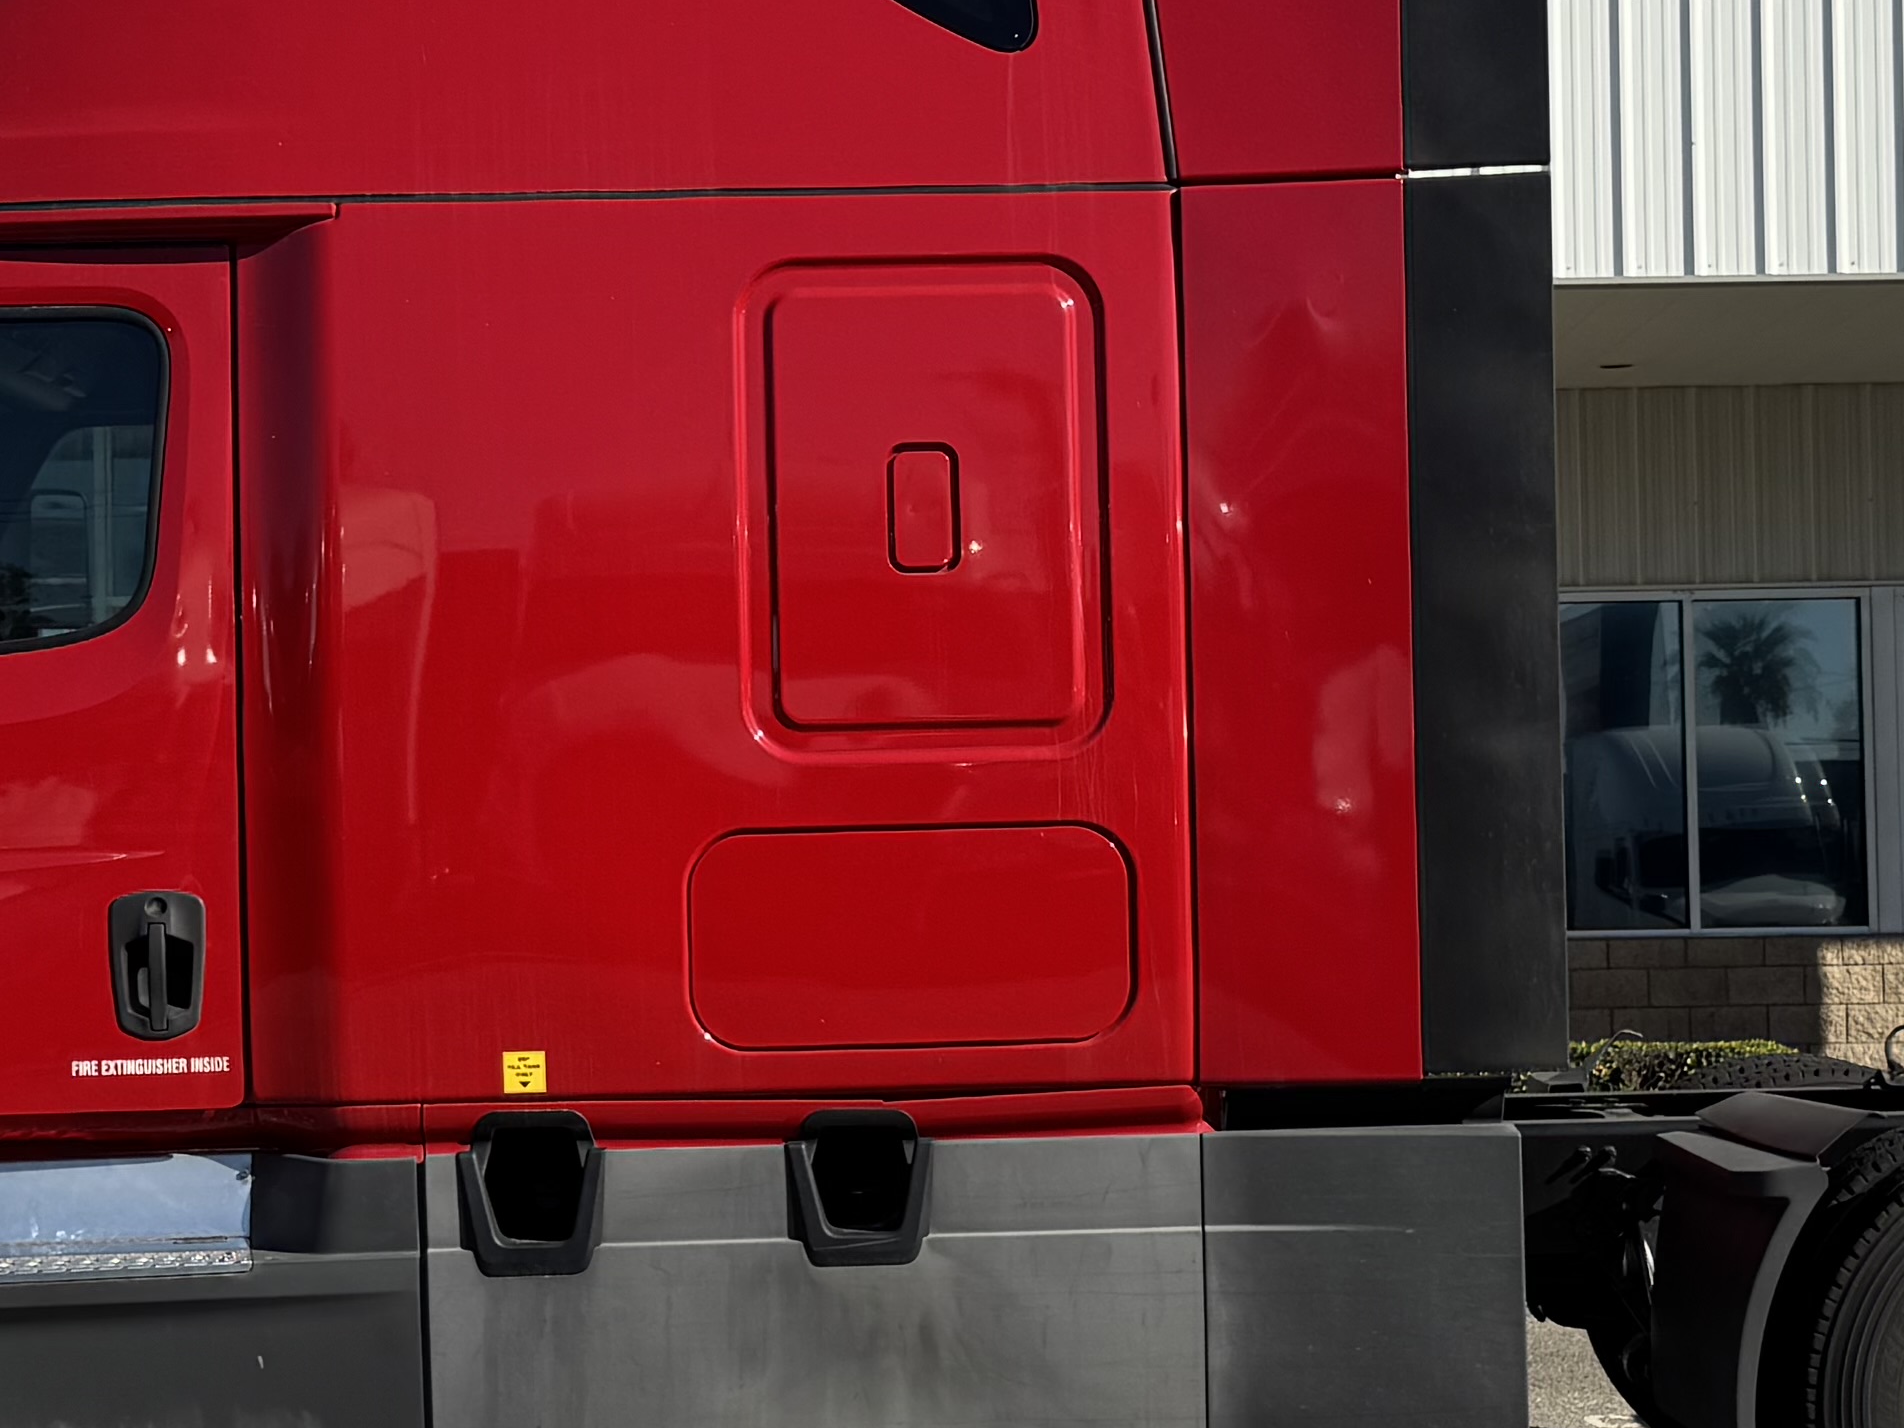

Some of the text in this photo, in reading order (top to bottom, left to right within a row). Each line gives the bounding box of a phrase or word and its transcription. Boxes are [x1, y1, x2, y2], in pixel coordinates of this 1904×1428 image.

[71, 1056, 230, 1076] FIRE EXTINGUISHER INSIDE
